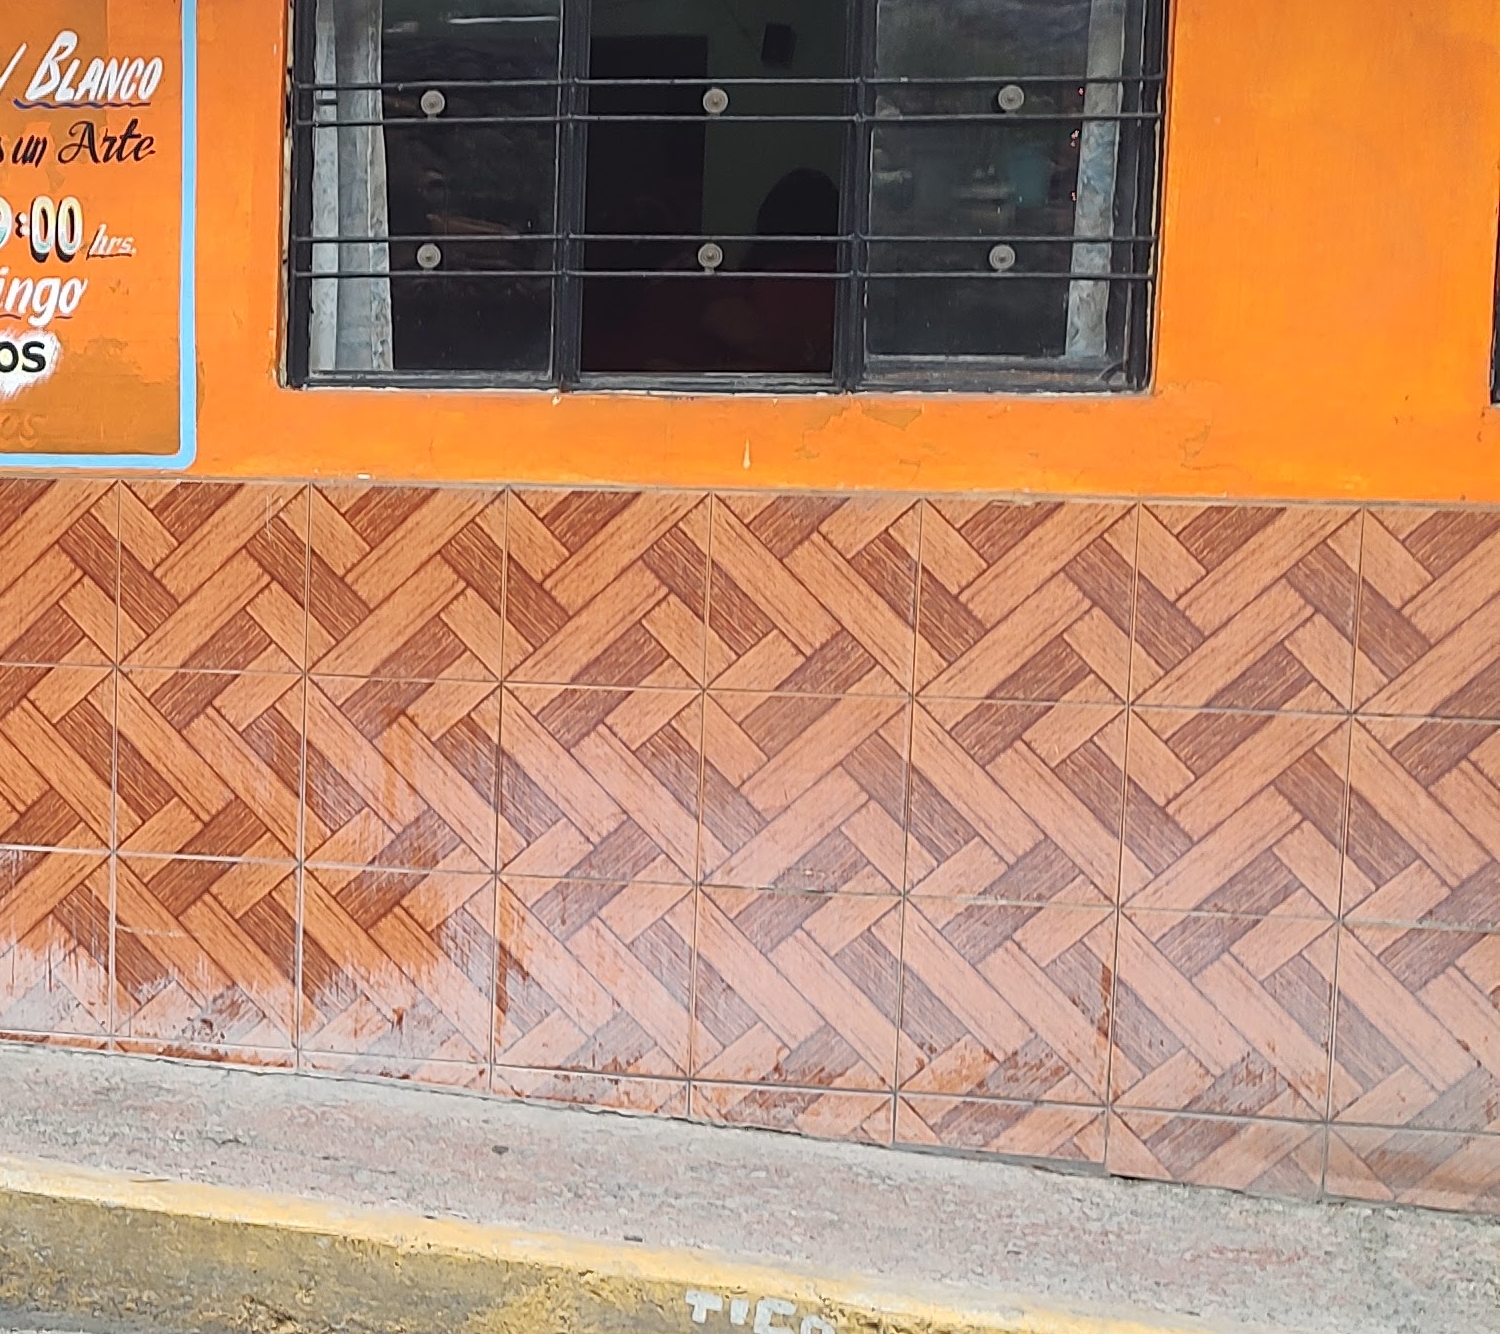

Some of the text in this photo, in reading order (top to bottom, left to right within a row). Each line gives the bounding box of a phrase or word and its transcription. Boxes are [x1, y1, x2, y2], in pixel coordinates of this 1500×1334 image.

[20, 29, 164, 107] BLANCO
[10, 134, 48, 167] un
[57, 118, 157, 166] Arte
[87, 222, 137, 260] hrs.
